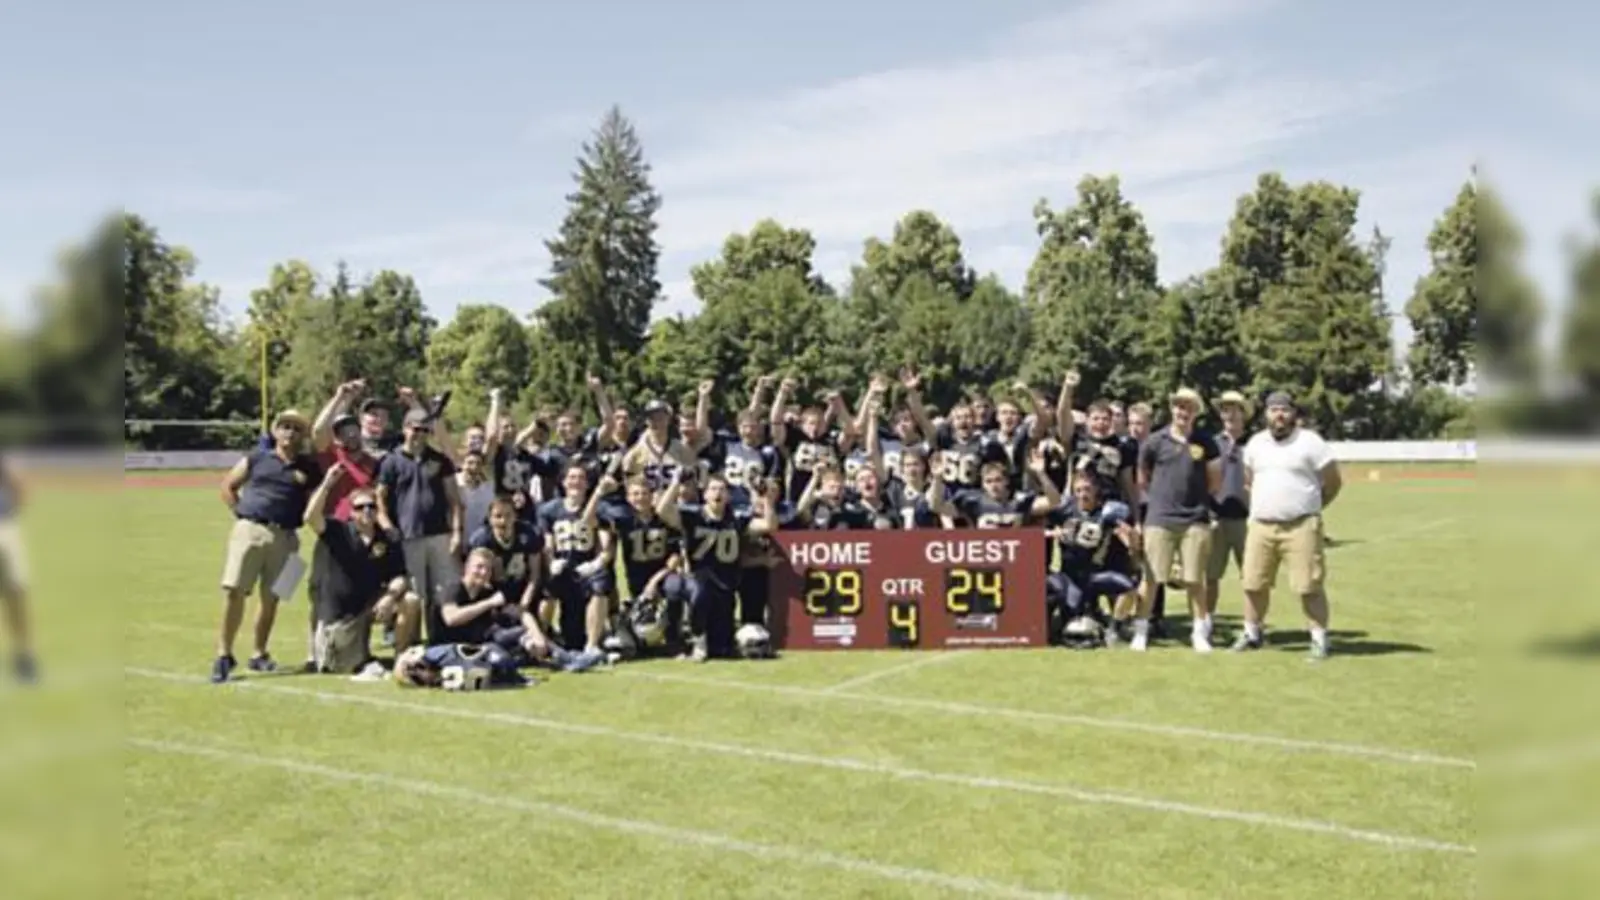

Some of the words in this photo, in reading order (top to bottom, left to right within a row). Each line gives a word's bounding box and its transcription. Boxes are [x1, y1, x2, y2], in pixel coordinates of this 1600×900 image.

[693, 528, 739, 563] 70
[790, 541, 872, 565] HOME
[925, 540, 1021, 564] GUEST
[806, 570, 862, 614] 29
[881, 578, 924, 596] QTR
[946, 569, 1002, 613] 24
[890, 604, 917, 641] 4
